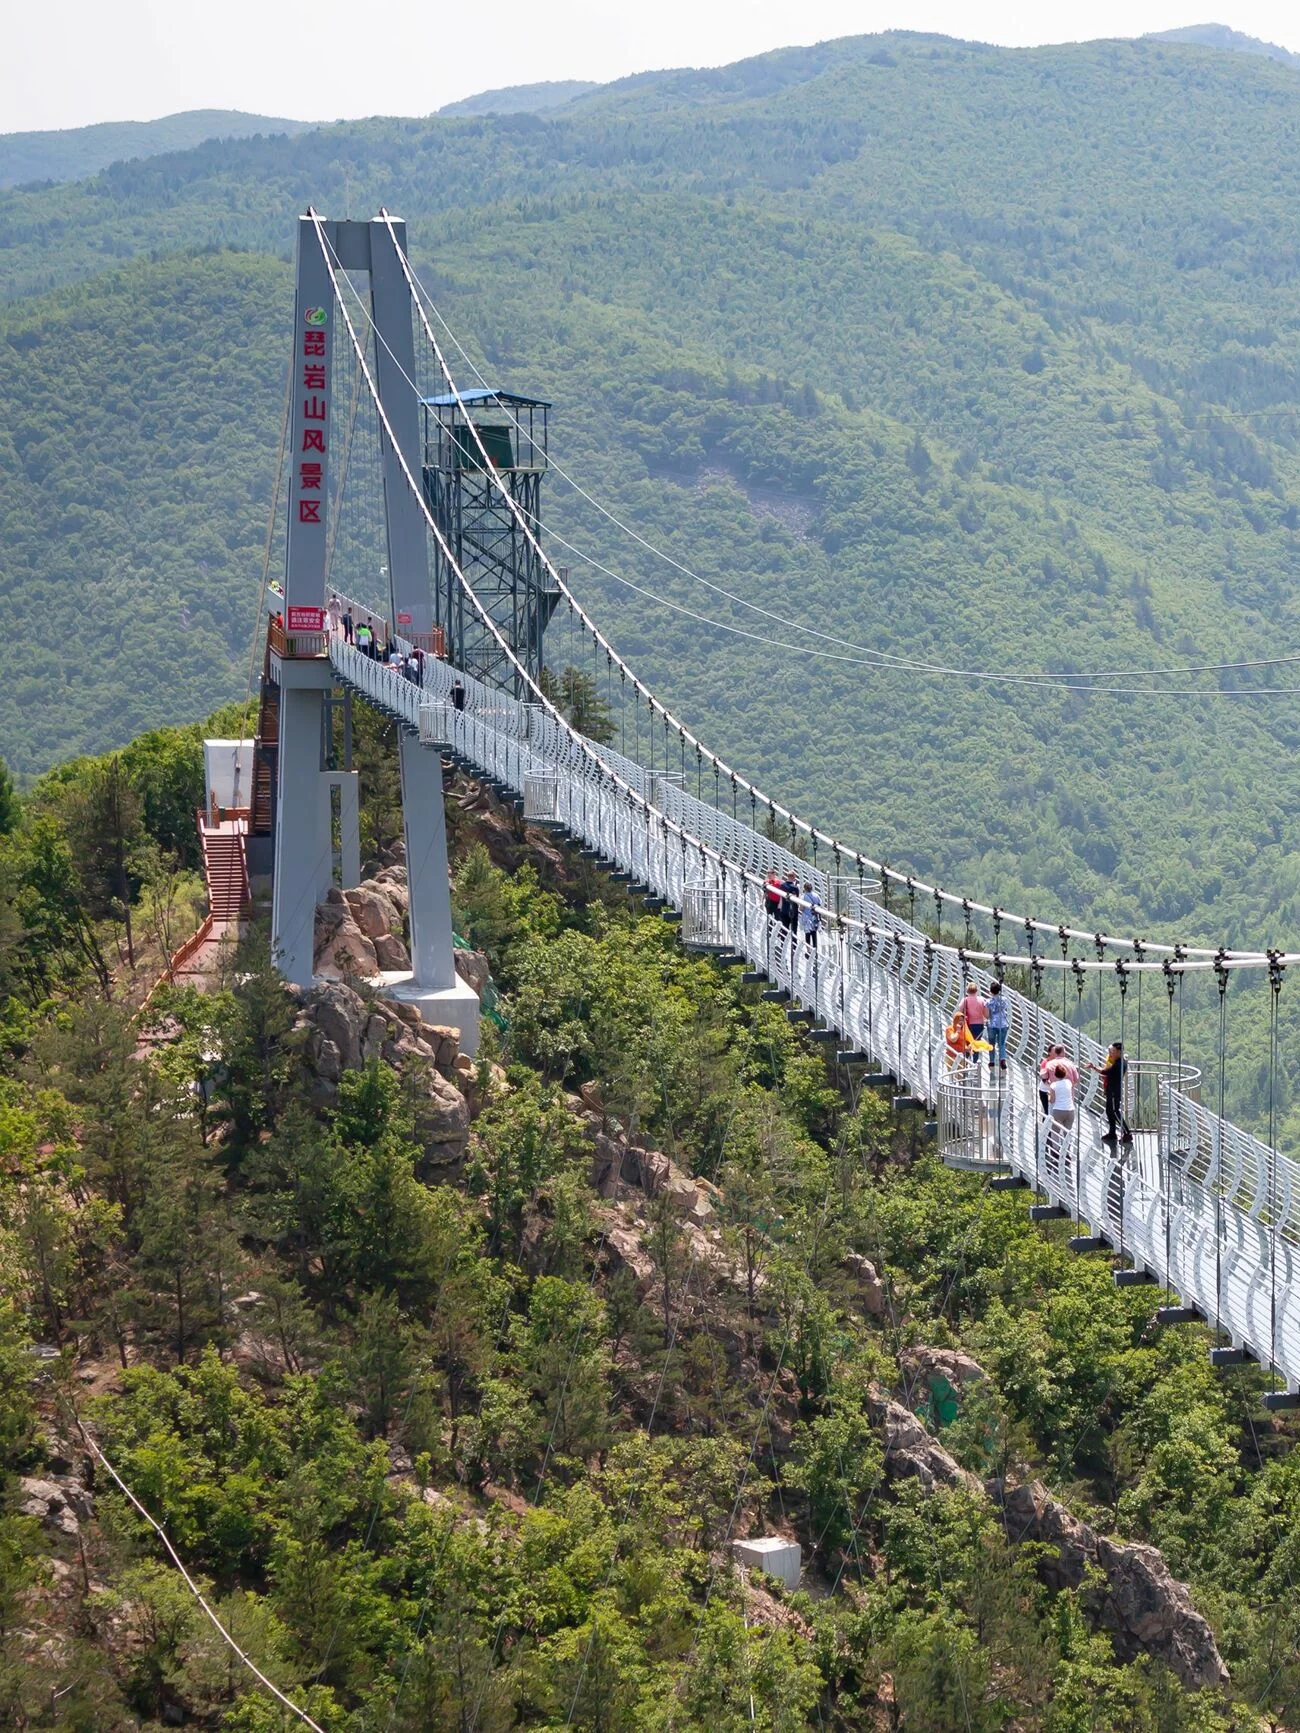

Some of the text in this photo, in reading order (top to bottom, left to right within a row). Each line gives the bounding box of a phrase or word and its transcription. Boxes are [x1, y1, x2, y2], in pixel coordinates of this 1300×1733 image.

[299, 331, 326, 523] 琵岩山风景区
